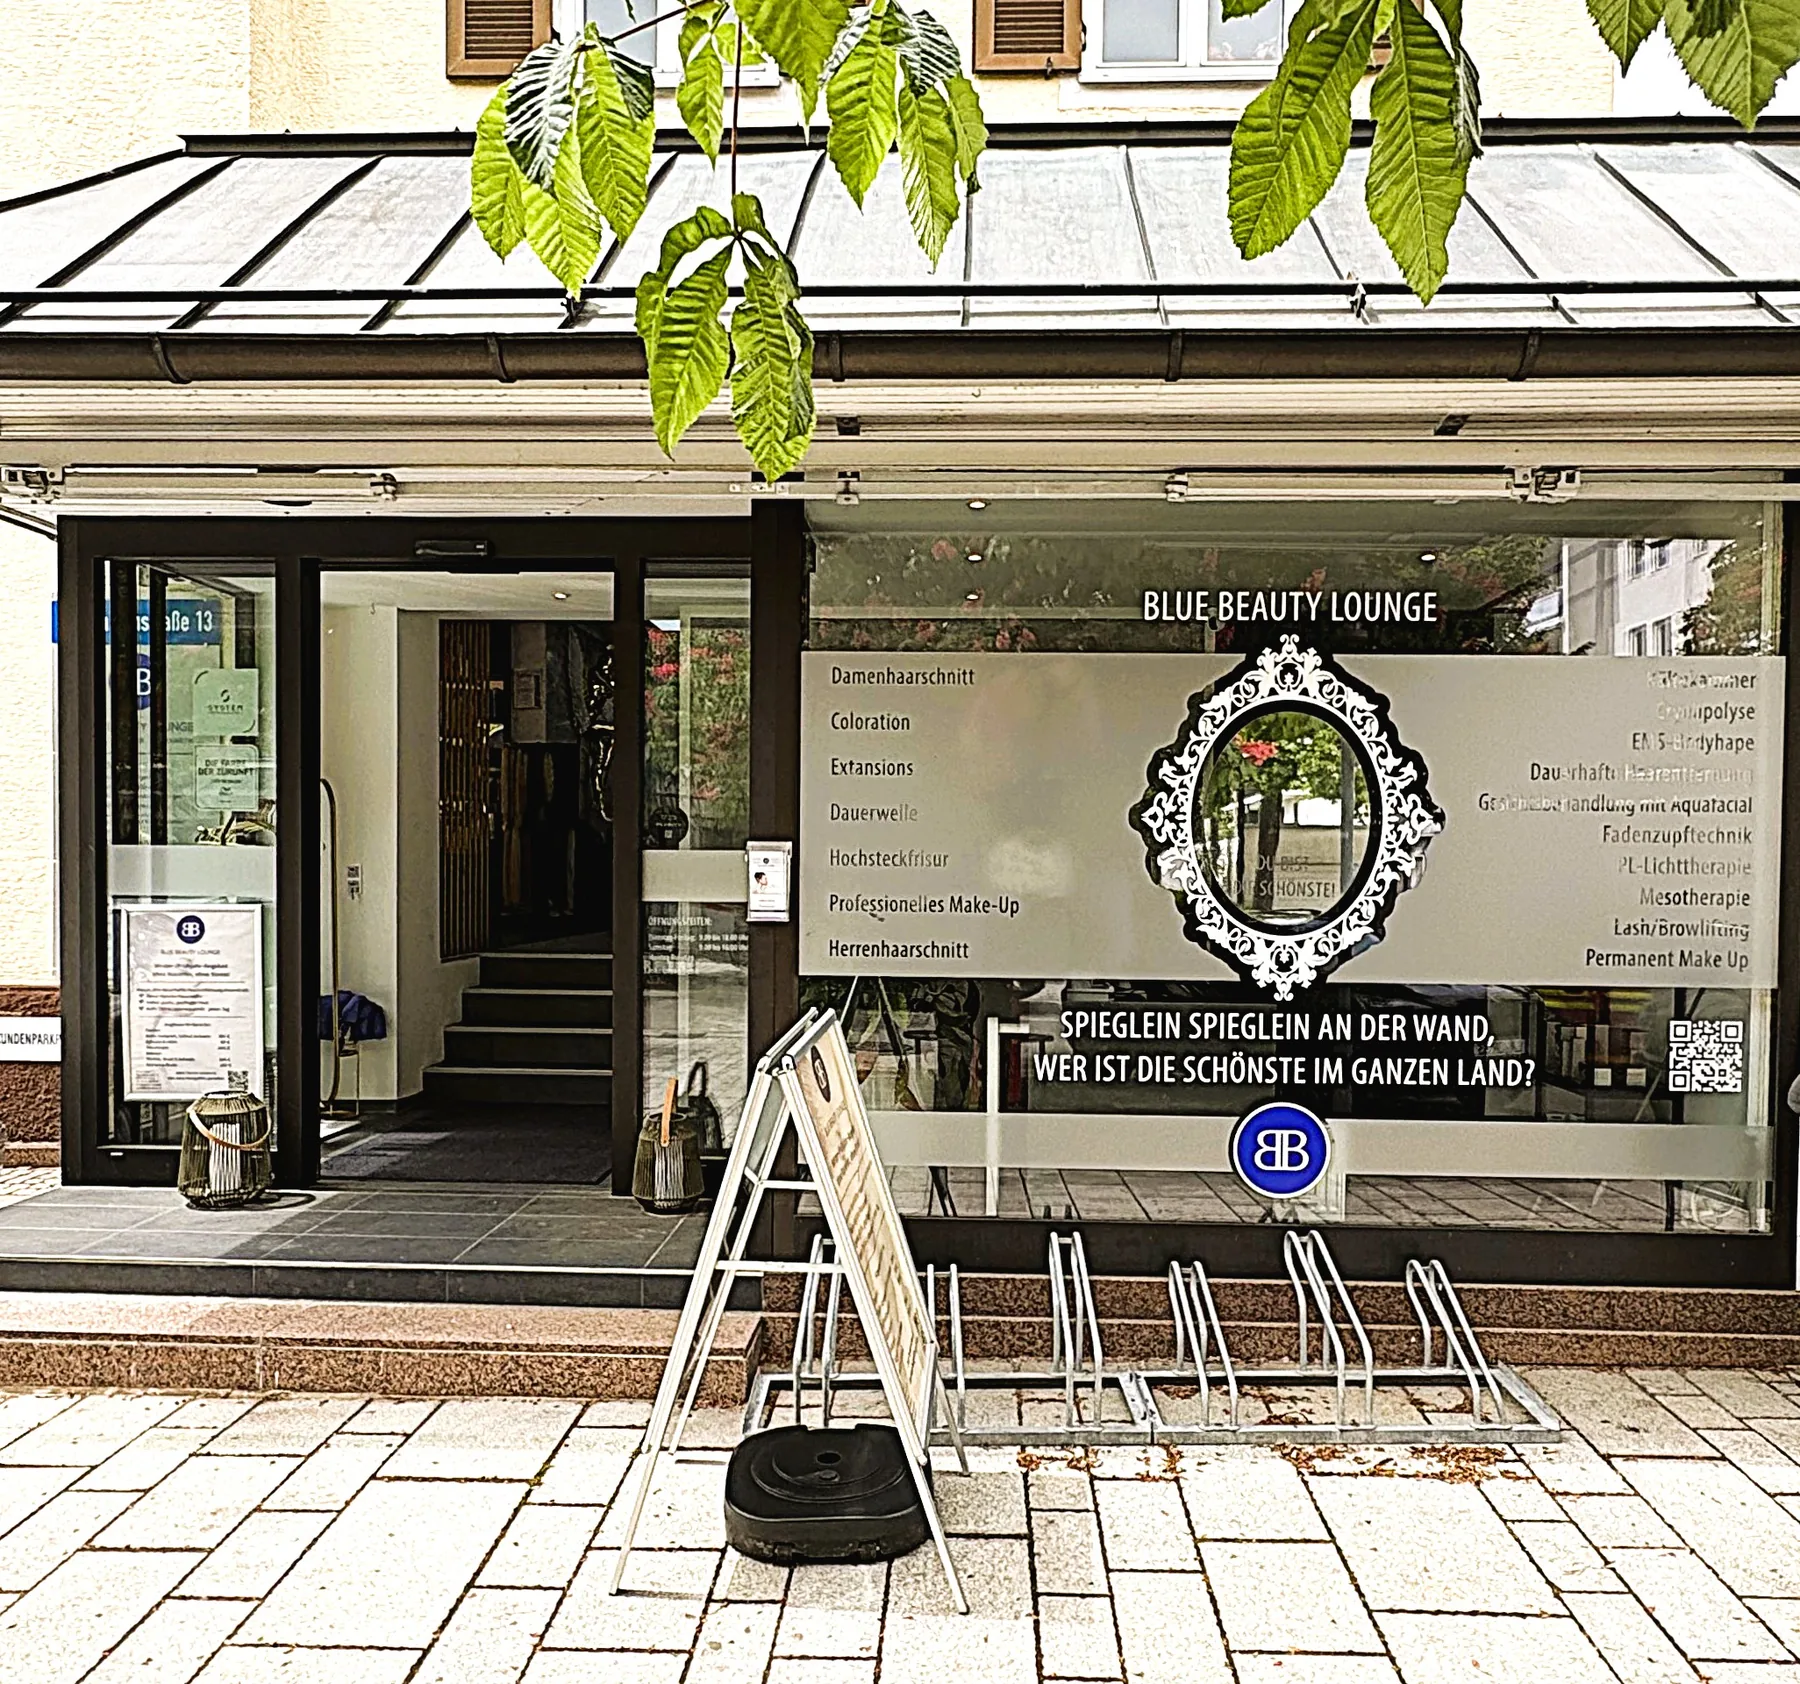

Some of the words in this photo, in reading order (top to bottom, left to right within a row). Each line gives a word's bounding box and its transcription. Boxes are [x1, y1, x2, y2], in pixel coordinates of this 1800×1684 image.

[1143, 591, 1209, 621] BLUE
[1217, 591, 1323, 622] BEAUTY
[1331, 591, 1439, 622] LOUNGE
[195, 610, 213, 633] 13
[831, 666, 975, 685] Damenhaarschnitt
[831, 711, 911, 731] Coloration
[831, 758, 914, 777] Extansions
[830, 803, 919, 822] Dauerwelle
[1602, 825, 1753, 848] Fadenzupftechnik
[830, 849, 949, 868] Hochsteckfrisur
[829, 894, 945, 914] Professionelles
[949, 895, 1020, 918] Make-Up
[1640, 887, 1751, 910] Mesotherapie
[829, 939, 969, 959] Herrenhaarschnitt
[1585, 948, 1674, 968] Permanent
[1679, 949, 1722, 968] Make
[1727, 950, 1749, 972] Up
[1060, 1011, 1181, 1040] SPIEGLEIN
[1188, 1012, 1310, 1041] SPIEGLEIN
[1317, 1013, 1353, 1041] AN
[1360, 1013, 1406, 1041] DER
[1412, 1014, 1495, 1047] WAND,
[1034, 1054, 1088, 1083] WER
[1094, 1054, 1130, 1083] IST
[1138, 1055, 1175, 1083] DIE
[1182, 1050, 1307, 1085] SCHÖNSTE
[1314, 1057, 1344, 1085] IM
[1351, 1057, 1450, 1086] GANZEN
[1457, 1058, 1536, 1087] LAND?
